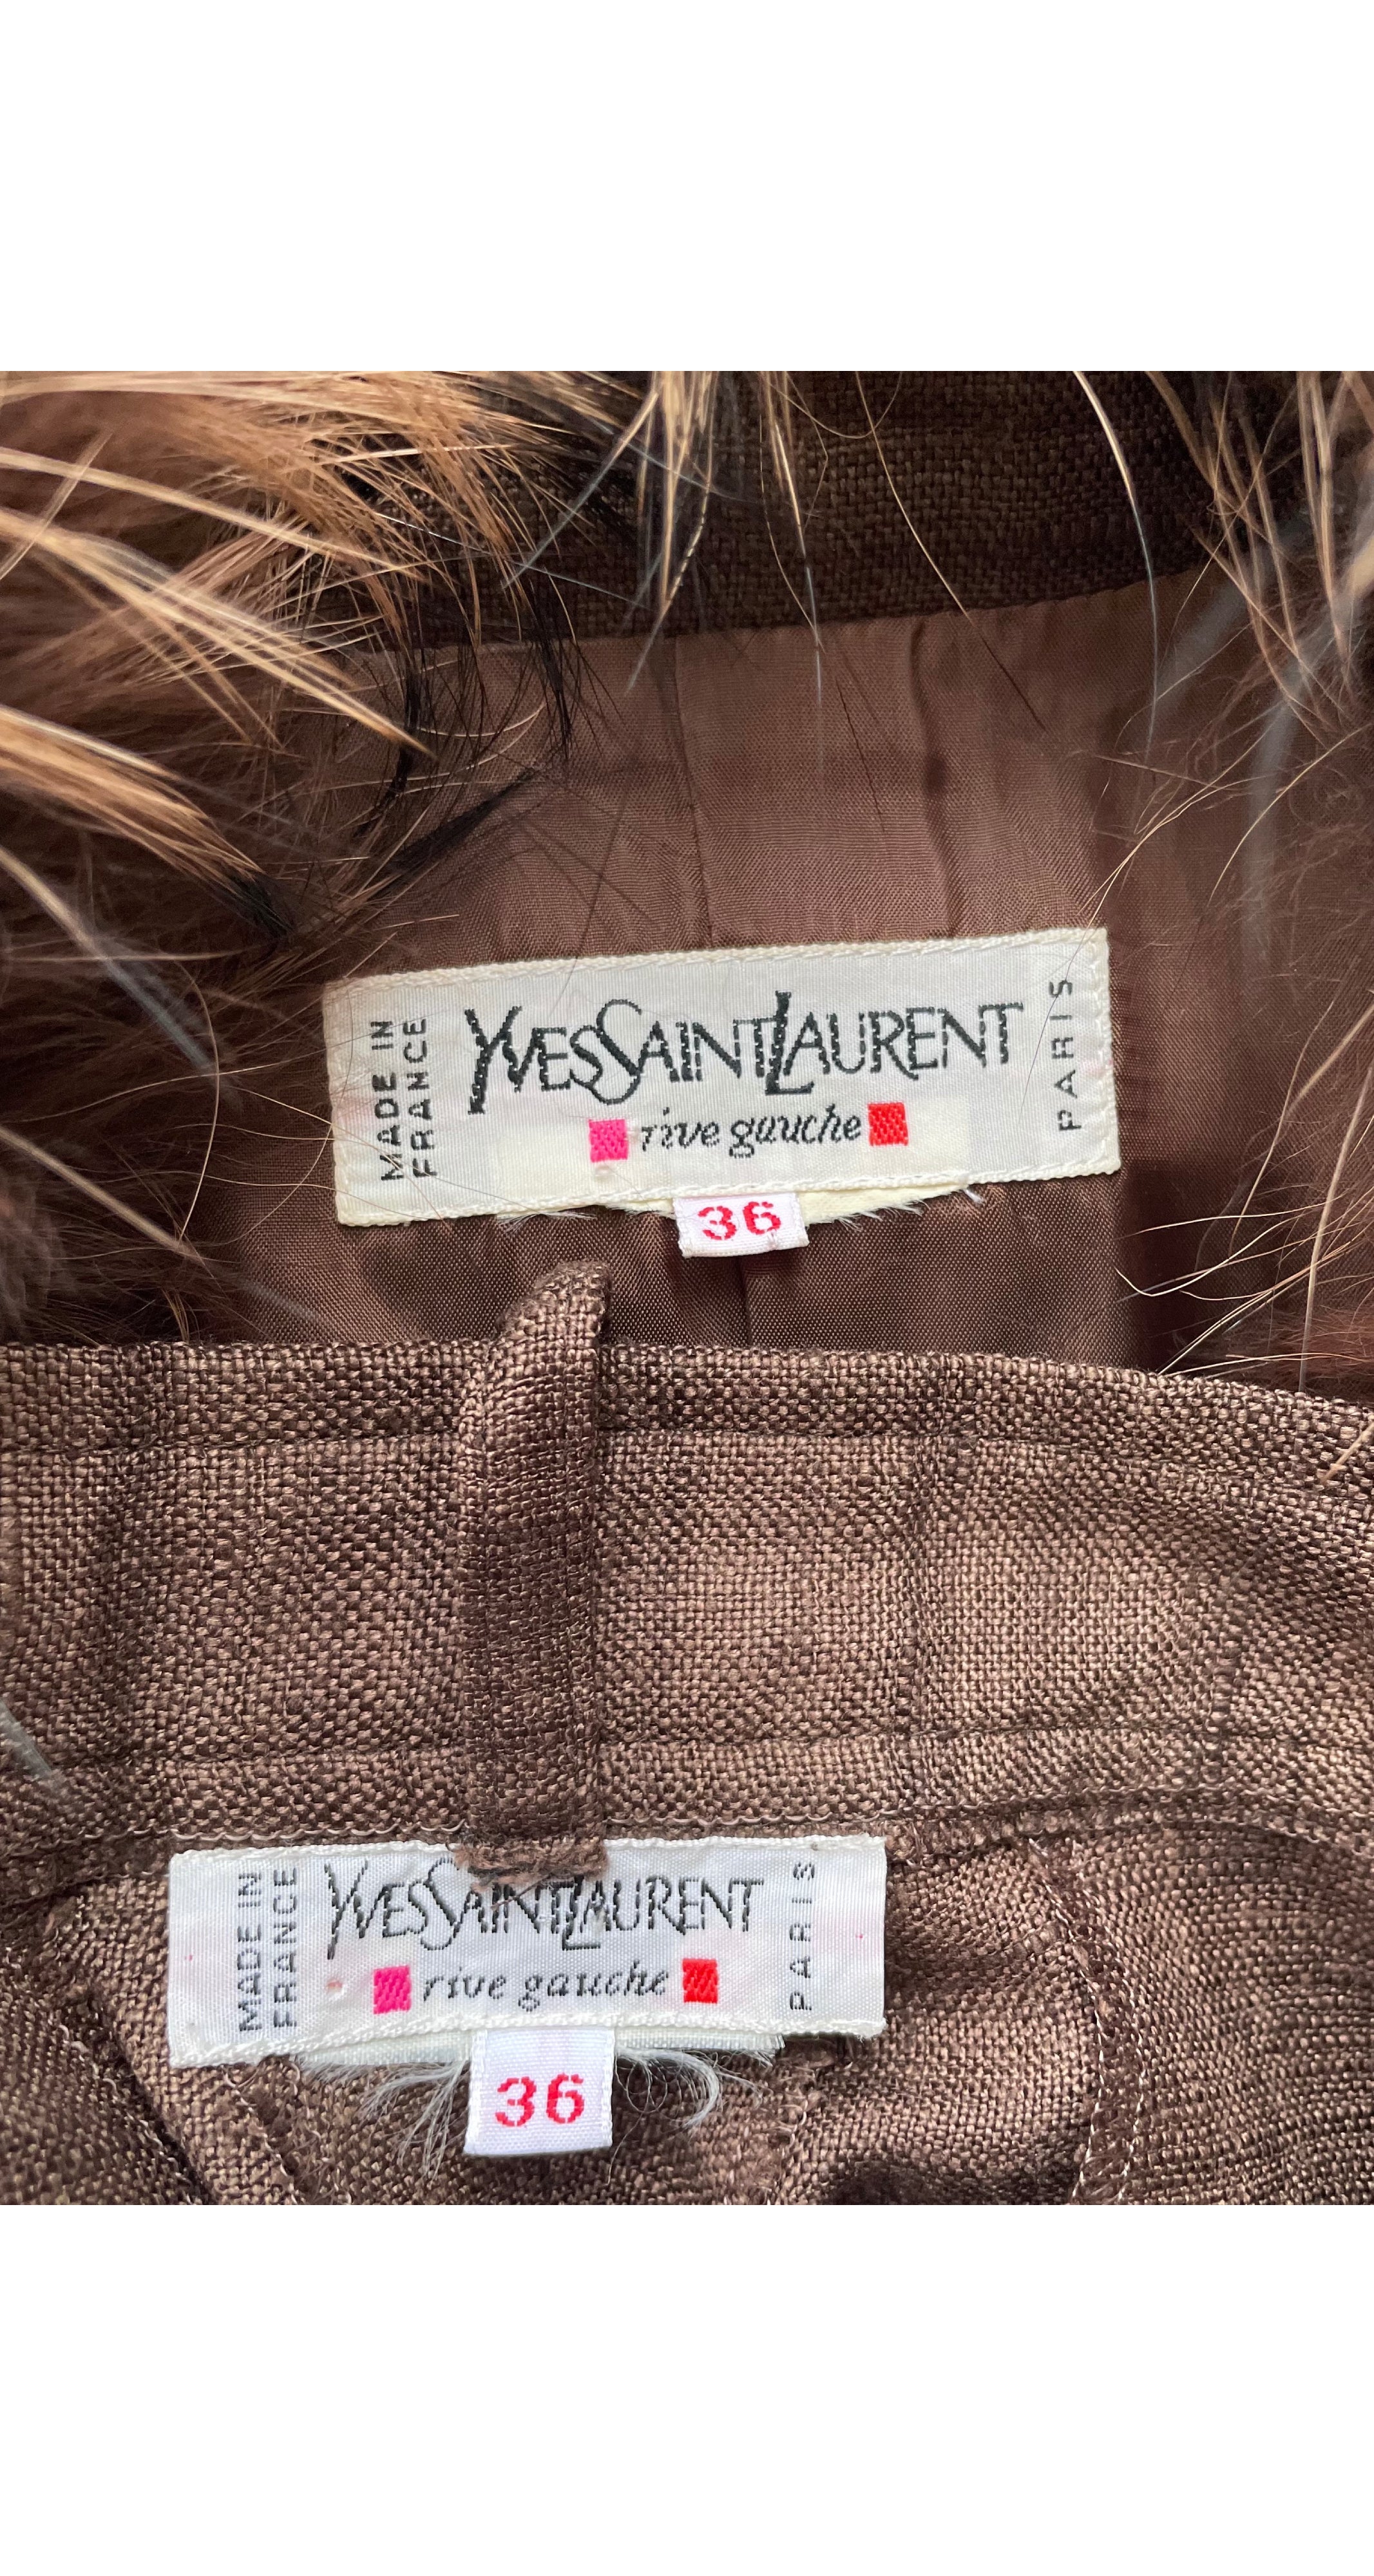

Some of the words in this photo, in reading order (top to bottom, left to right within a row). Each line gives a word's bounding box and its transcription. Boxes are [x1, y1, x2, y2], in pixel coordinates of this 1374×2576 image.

[370, 1020, 394, 1050] IN
[1049, 979, 1082, 1132] PARIS
[371, 1072, 405, 1180] MADE
[403, 1018, 438, 1178] FRANCE
[641, 1106, 720, 1151] rive
[729, 1103, 861, 1159] gauche
[698, 1200, 782, 1240] 36
[238, 1871, 262, 1908] IN
[273, 1868, 298, 2028] FRANCE
[788, 1861, 816, 2011] PARIS
[237, 1926, 262, 2031] MADE
[423, 1967, 506, 2001] rive
[518, 1958, 669, 2012] gauche
[495, 2072, 584, 2127] 36
